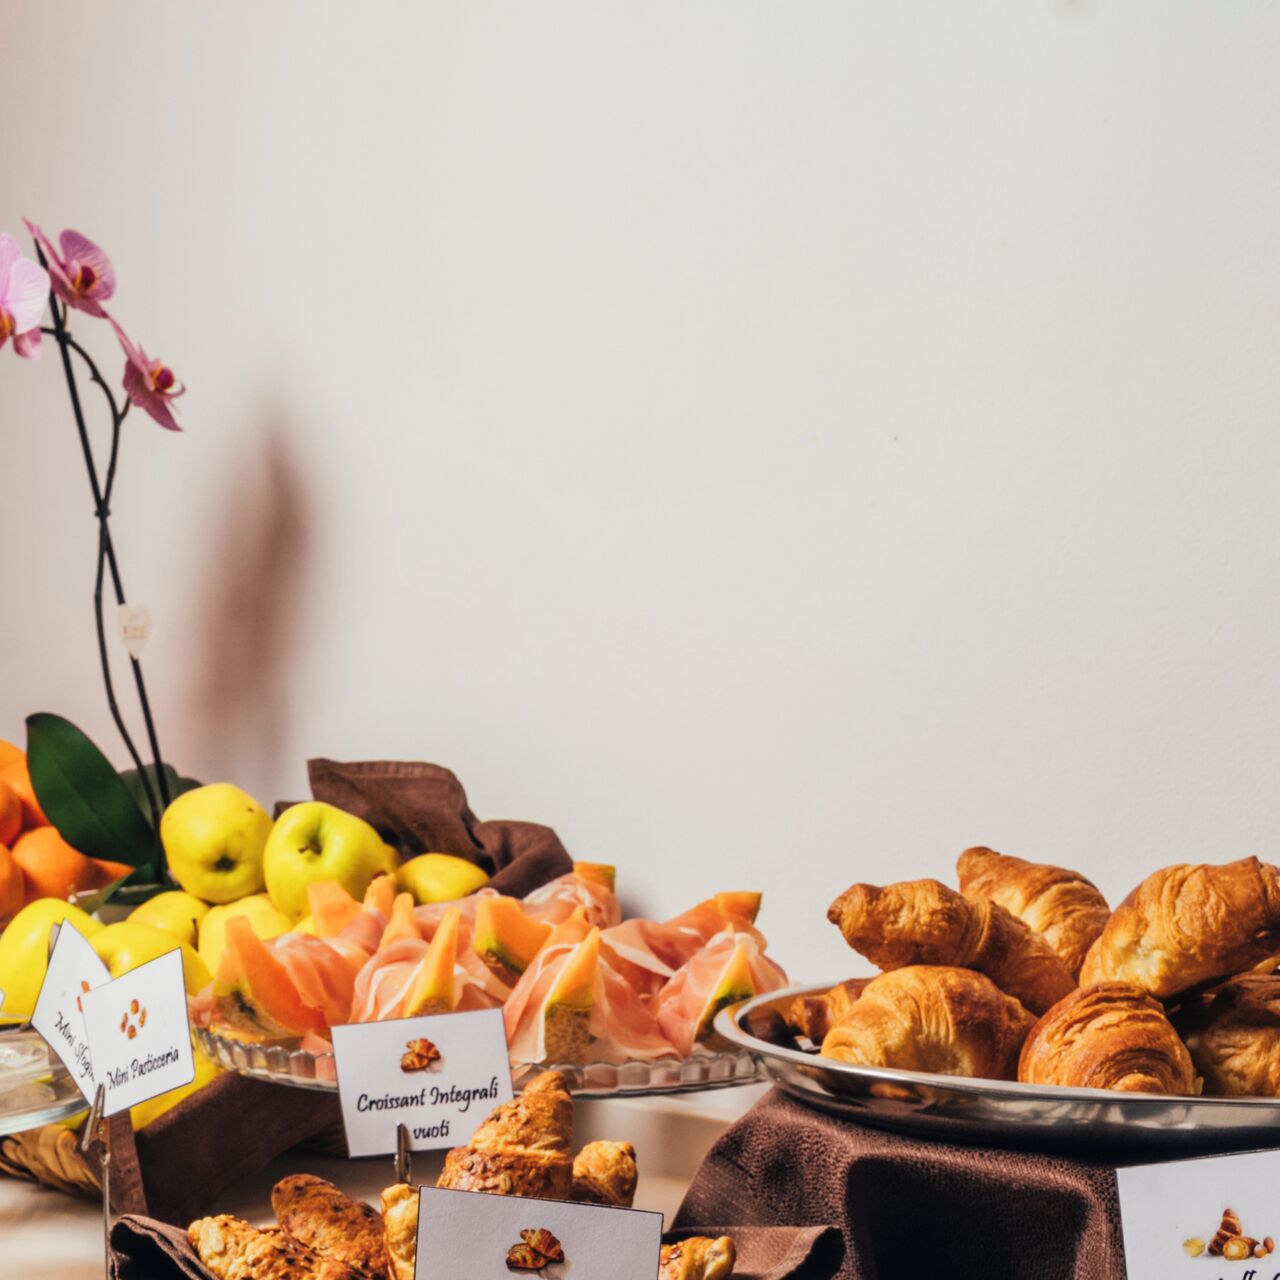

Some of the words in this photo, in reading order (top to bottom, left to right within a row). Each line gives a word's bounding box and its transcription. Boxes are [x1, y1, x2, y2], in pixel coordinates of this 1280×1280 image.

[54, 1010, 77, 1047] Mini
[106, 1066, 129, 1091] Mini
[130, 1045, 179, 1079] Pasticceria
[356, 1087, 426, 1113] Croissant
[429, 1076, 500, 1113] Integrali
[412, 1118, 450, 1140] vuoti
